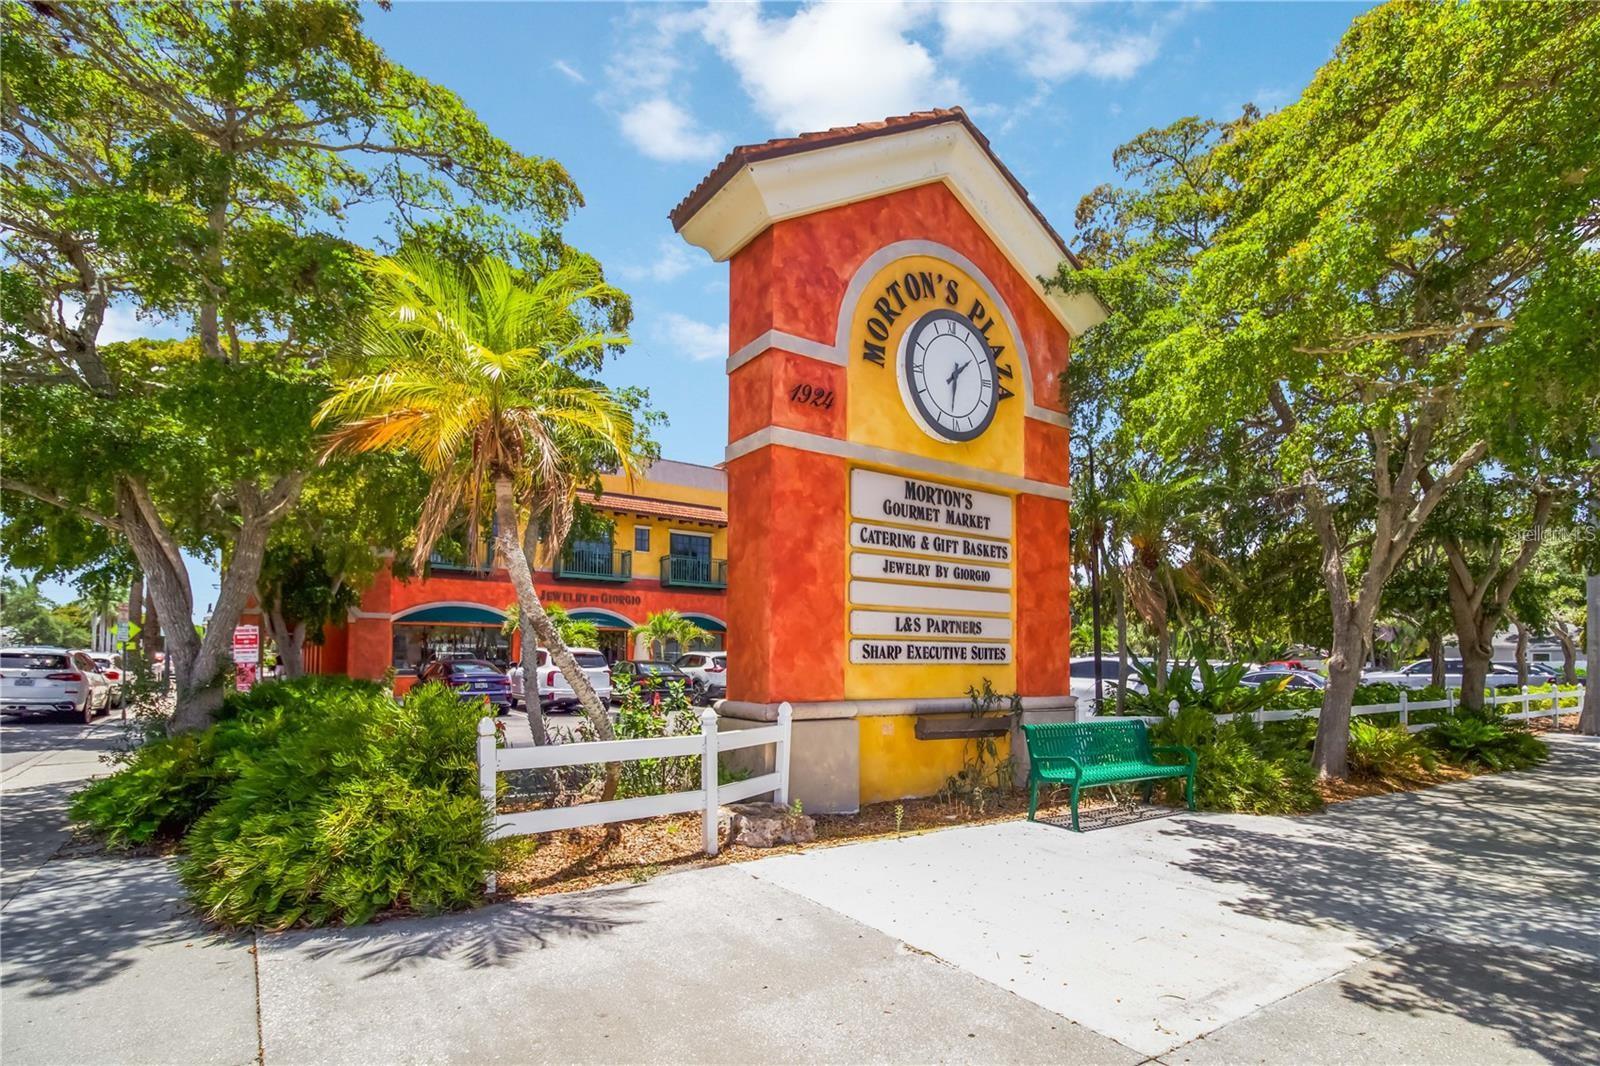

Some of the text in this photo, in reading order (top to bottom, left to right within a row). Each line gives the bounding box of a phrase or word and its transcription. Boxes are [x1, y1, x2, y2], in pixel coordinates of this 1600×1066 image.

[863, 271, 1015, 402] MORTON'S PLAZA
[791, 384, 834, 409] 1924
[905, 481, 973, 510] MORTON'S
[883, 499, 991, 530] GOURMET MARKET
[860, 527, 1008, 560] CATERING & GIFT BASKETS
[883, 559, 991, 583] JEWELRY BY GIORGIO
[541, 590, 588, 603] JEWELRY
[601, 592, 641, 605] GIORGIO
[895, 616, 982, 635] L&S PARTNERS
[862, 644, 1006, 661] SHARP EXECUTIVE SUITES
